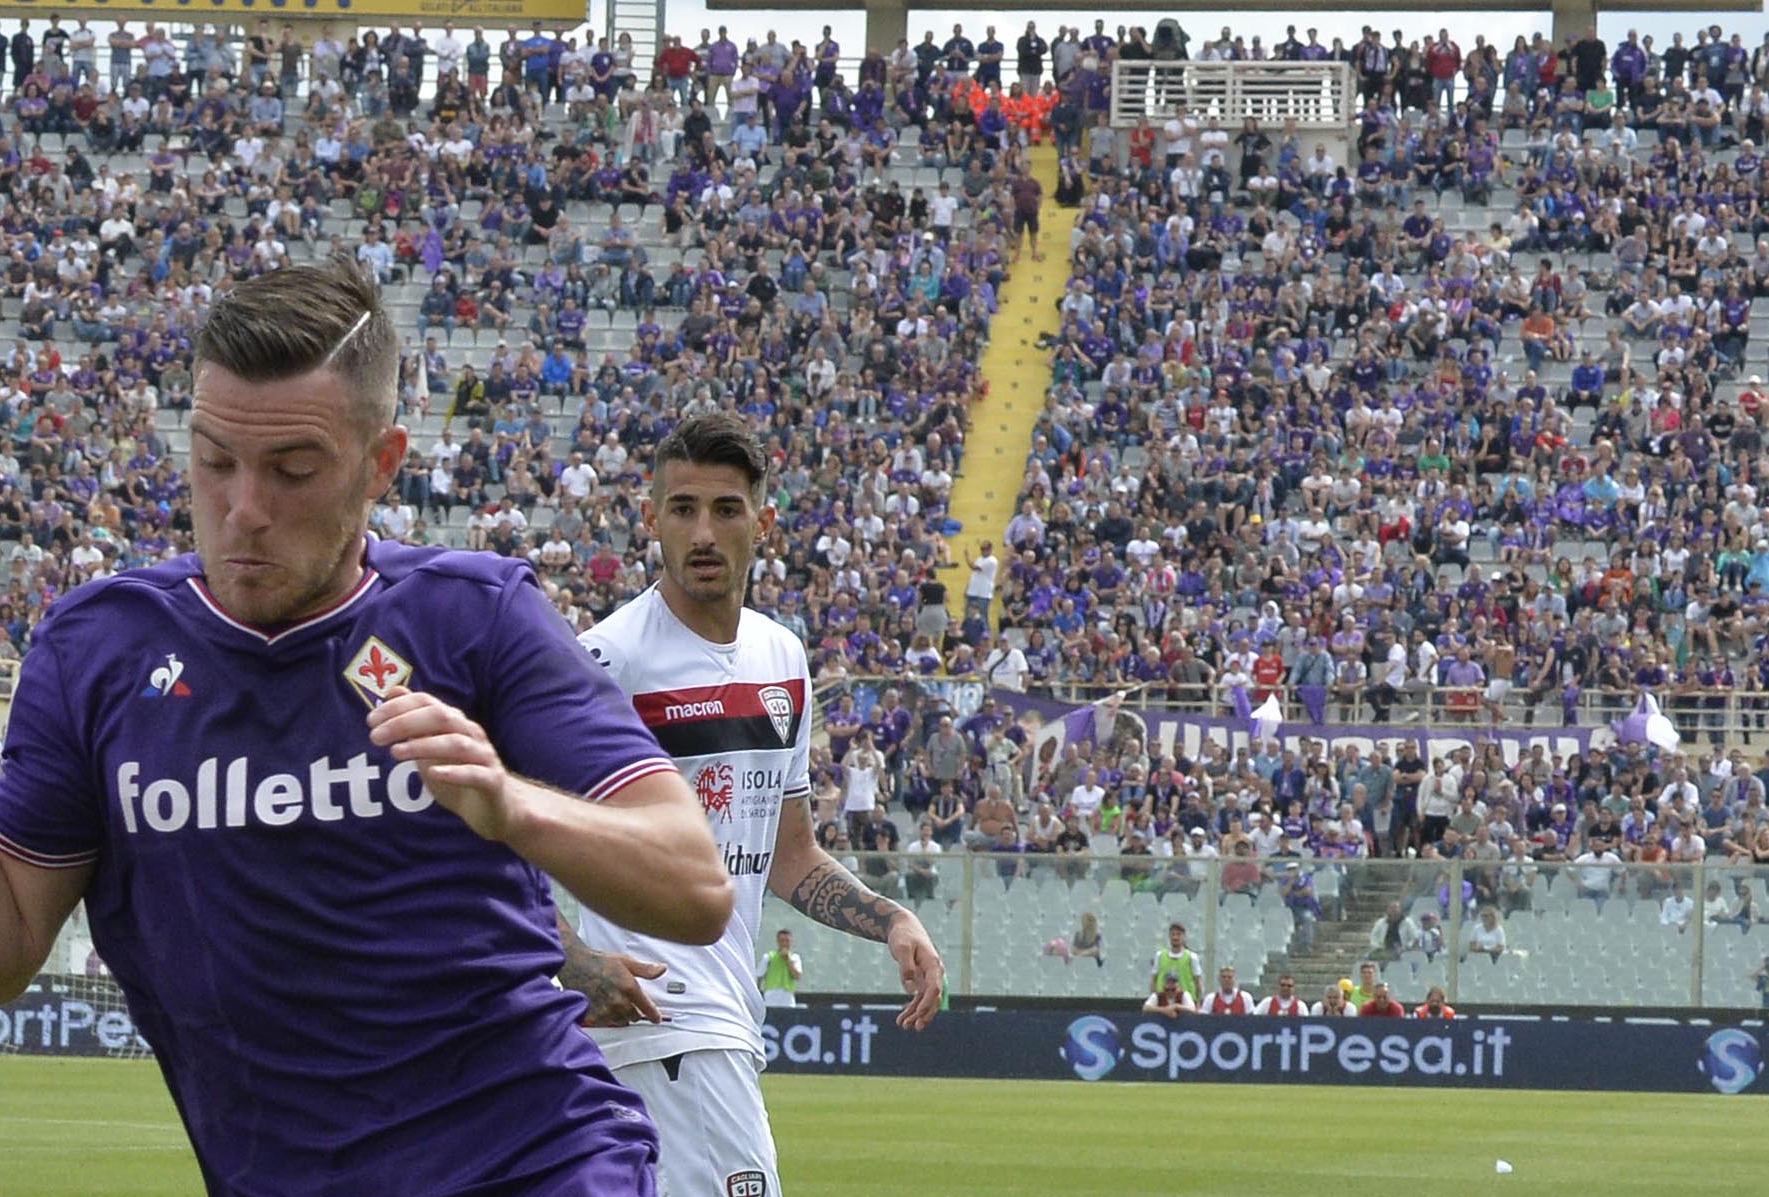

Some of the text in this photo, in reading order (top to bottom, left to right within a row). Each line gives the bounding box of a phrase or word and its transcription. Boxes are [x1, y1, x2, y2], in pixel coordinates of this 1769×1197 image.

[665, 700, 724, 720] macron
[117, 752, 435, 834] folletto
[741, 770, 782, 790] ISOLA
[1130, 1023, 1512, 1079] SportPesa.it
